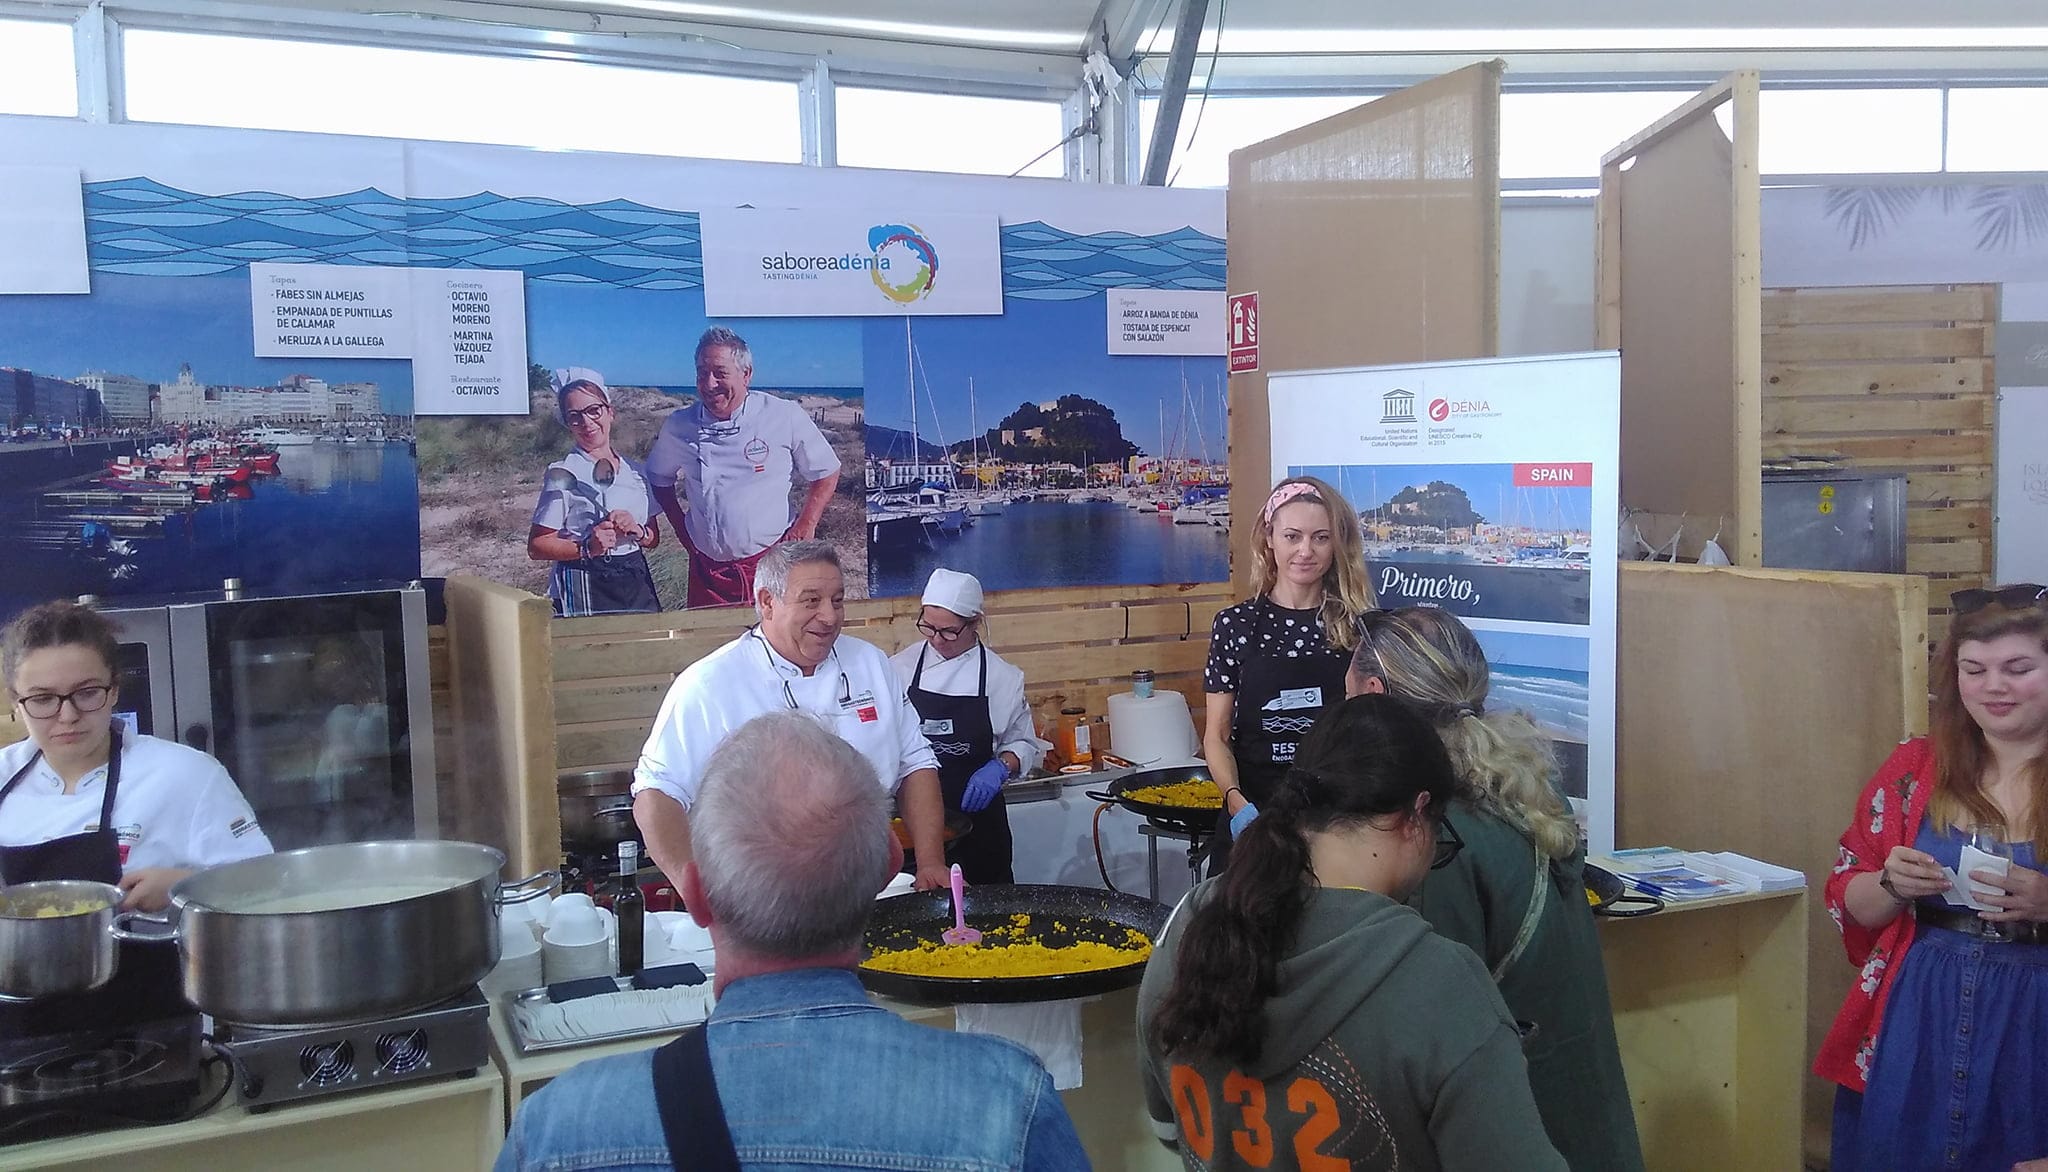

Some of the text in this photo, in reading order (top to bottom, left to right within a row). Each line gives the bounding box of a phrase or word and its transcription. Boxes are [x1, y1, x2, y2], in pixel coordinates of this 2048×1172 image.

[269, 275, 296, 286] Tapas
[276, 289, 365, 302] FABES SIN ALMEJAS
[451, 291, 488, 301] OCTAVIO
[277, 306, 393, 318] EMPANADA DE PUNTILLAS
[452, 303, 490, 313] MORENO
[453, 315, 491, 325] MORENO
[1123, 310, 1143, 318] ARROZ
[1144, 310, 1149, 318] A
[1150, 311, 1170, 319] BANDA
[1171, 311, 1179, 319] DE
[277, 318, 335, 329] DE CALAMAR
[1123, 323, 1191, 332] TOSTADA DE ESPENCAT
[278, 335, 385, 346] MERLUZA A LA GALLEGA
[454, 331, 493, 341] MARTINA
[1123, 333, 1136, 341] CON
[453, 341, 492, 352] VÁZQUEZ
[454, 354, 485, 365] TEJADA
[456, 386, 500, 395] OCTAVIO'S
[1451, 400, 1490, 412] DÉNIA
[1531, 468, 1574, 481] SPAIN
[1379, 566, 1481, 605] Primero,
[1170, 1064, 1351, 1172] 032
